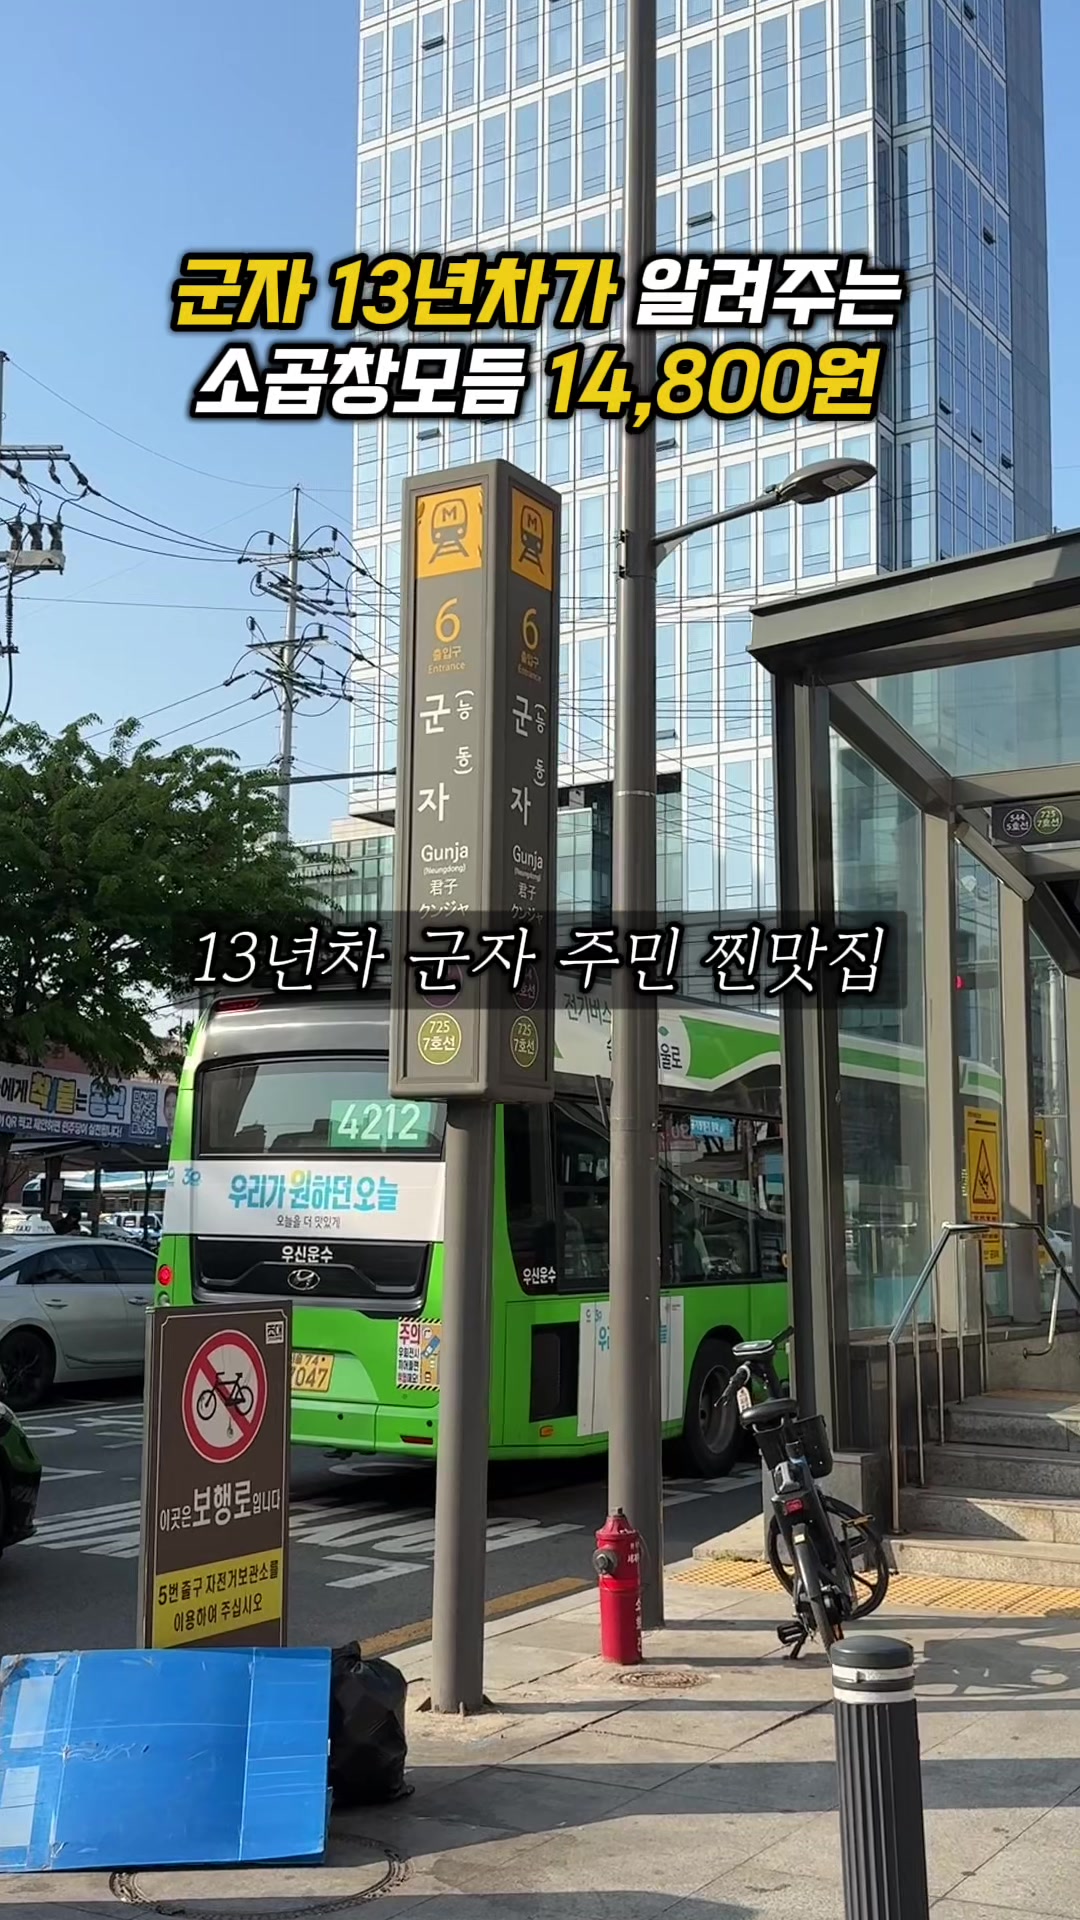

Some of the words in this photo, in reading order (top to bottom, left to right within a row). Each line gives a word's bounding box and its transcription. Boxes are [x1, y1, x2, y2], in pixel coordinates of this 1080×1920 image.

[435, 597, 461, 643] 6
[522, 607, 539, 650] 6
[432, 645, 462, 662] 출입구
[427, 661, 466, 675] Entrance
[1037, 817, 1060, 828] 7호선
[1040, 809, 1056, 819] 725
[1006, 820, 1029, 831] 5호선
[421, 842, 469, 863] Gunja
[512, 844, 544, 871] Gunja
[423, 863, 466, 876] (Neungdong)
[429, 878, 459, 896] 君子
[517, 881, 537, 901] 君子
[418, 899, 470, 920] クンジャ
[563, 992, 612, 1026] 전기버스
[429, 1020, 450, 1034] 725
[517, 1022, 532, 1037] 725
[422, 1035, 456, 1052] 7호선
[513, 1037, 535, 1055] 7호선
[337, 1103, 421, 1140] 4212
[228, 1174, 286, 1210] 우리가
[289, 1169, 352, 1211] 원하던
[353, 1176, 399, 1212] 오늘
[276, 1214, 301, 1229] 오늘을
[303, 1214, 312, 1229] 더
[314, 1215, 341, 1230] 맛있게
[281, 1244, 334, 1264] 우신운수
[522, 1265, 557, 1286] 우신운수
[399, 1323, 420, 1346] 주의
[159, 1505, 192, 1532] 이곳은
[158, 1582, 179, 1606] 5번
[205, 1559, 279, 1594] 자전거보관소를
[174, 1603, 218, 1633] 이용하여
[221, 1592, 263, 1621] 주십시오
